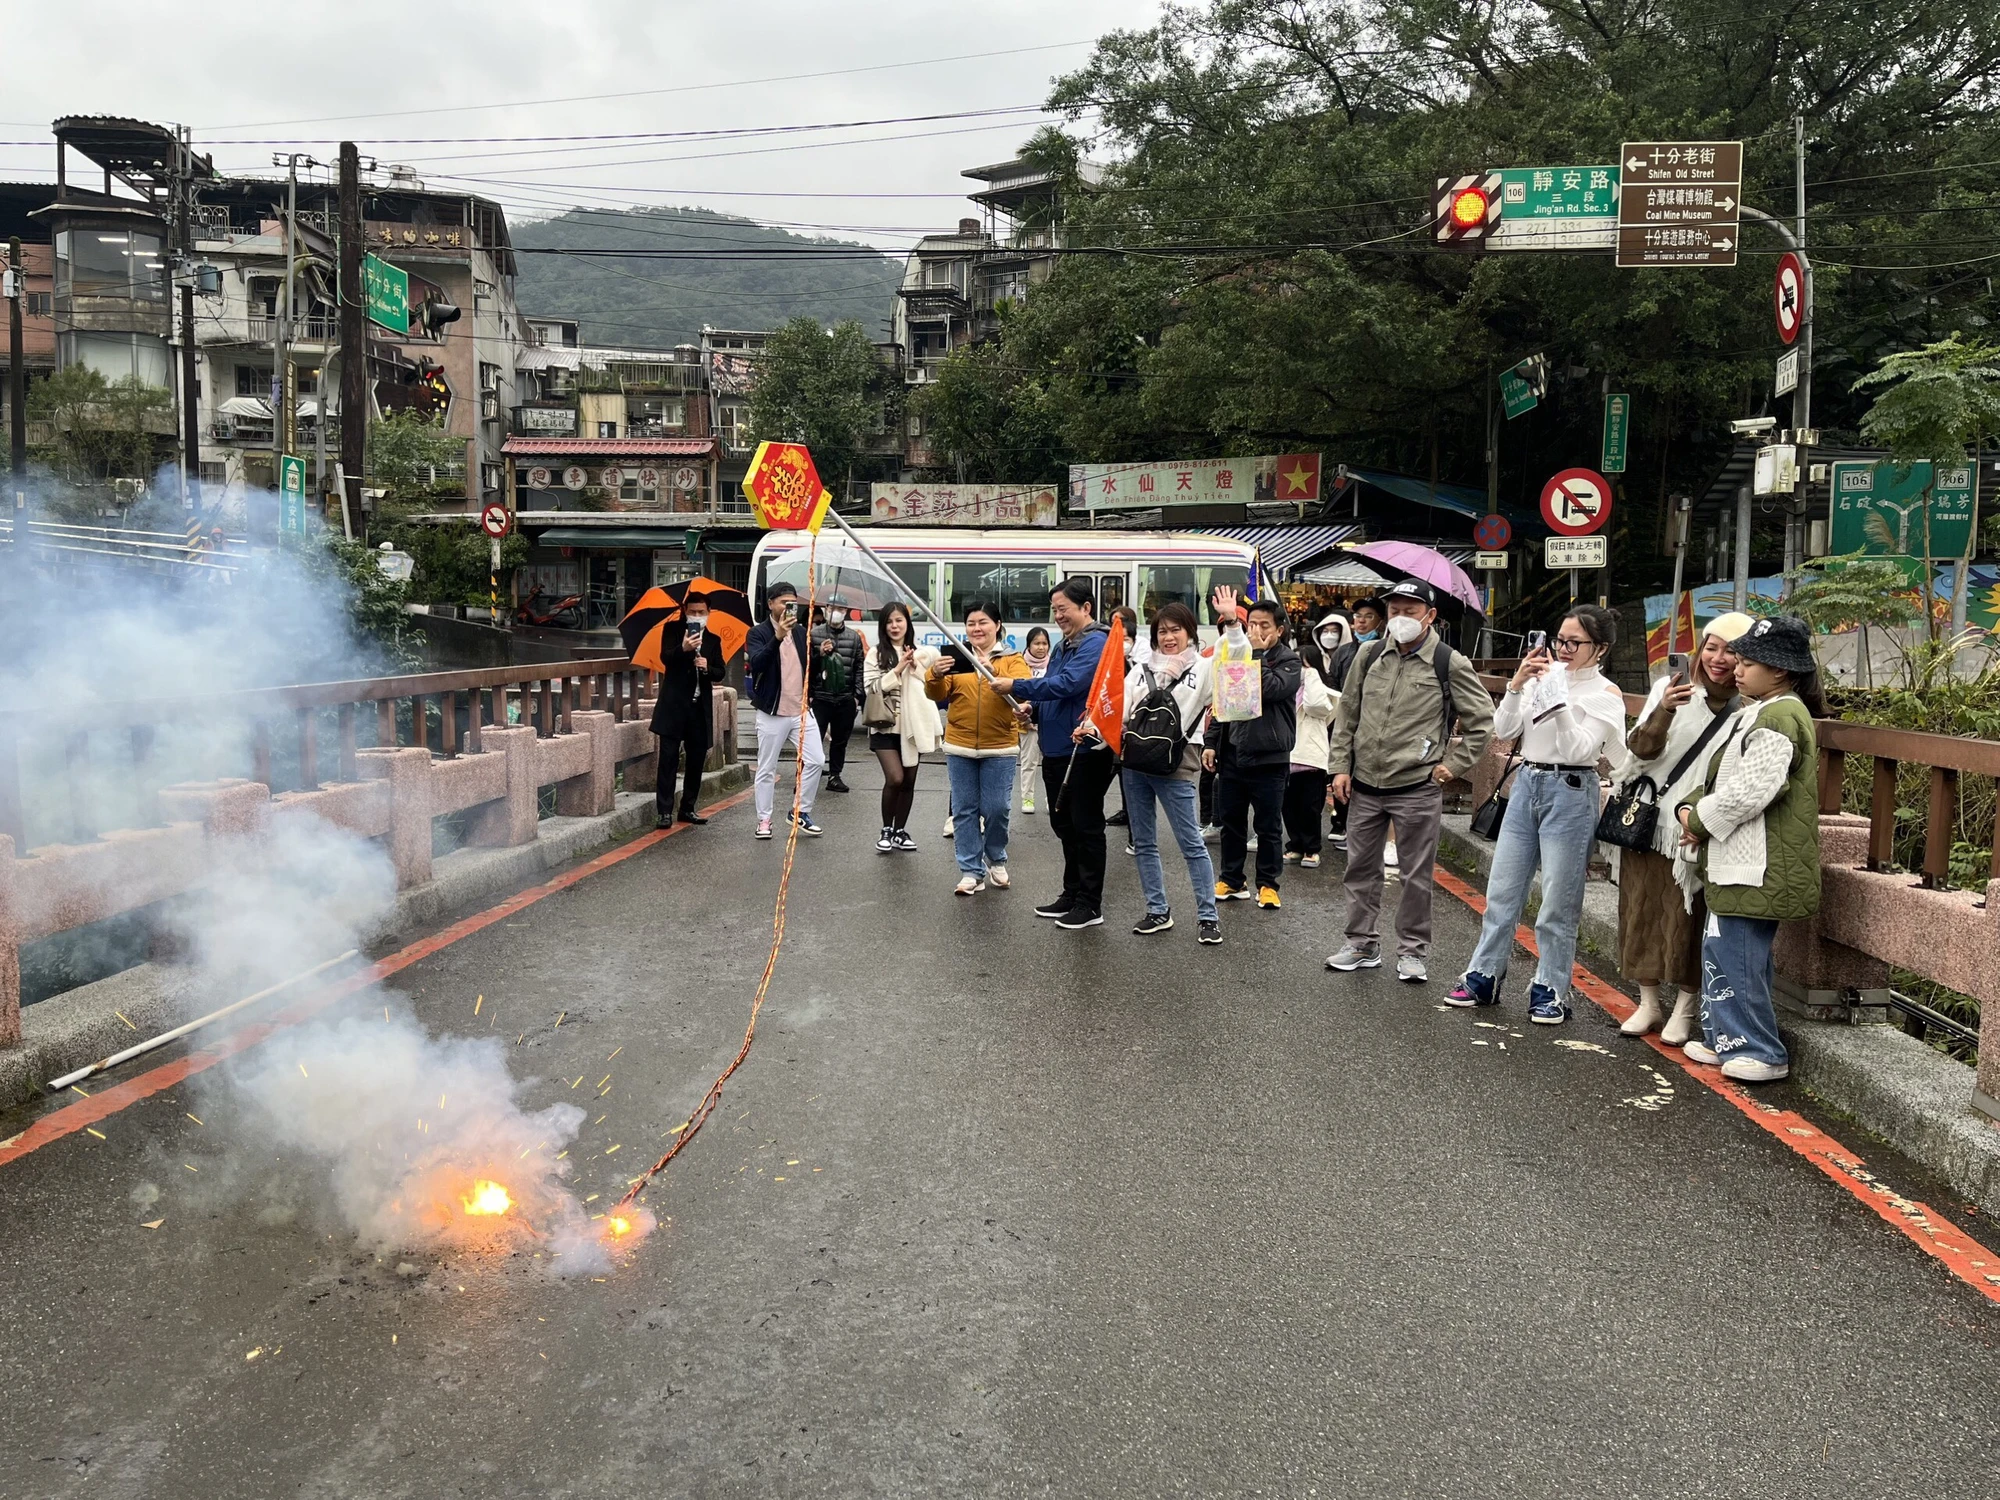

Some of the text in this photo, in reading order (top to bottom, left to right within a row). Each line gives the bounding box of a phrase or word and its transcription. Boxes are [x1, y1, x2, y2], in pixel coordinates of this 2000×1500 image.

[1648, 147, 1716, 165] 十分老街
[1648, 168, 1715, 179] Shifen Old Street
[1533, 170, 1610, 191] 靜安路
[1507, 187, 1523, 197] 106
[1551, 191, 1595, 203] 三段
[1646, 188, 1714, 206] 台灣煤礦博物館
[1534, 203, 1609, 215] Jing'an Rd. Sec. 3
[1645, 209, 1713, 220] Coal Mine Museum
[364, 226, 461, 247] 味的咖啡
[1644, 229, 1711, 247] 十分旅遊服務中心
[1168, 459, 1228, 470] 0975-812-611
[1101, 470, 1234, 495] 水仙天燈
[1845, 475, 1868, 487] 106
[902, 489, 1022, 519] 金莎小品
[1839, 496, 1873, 510] 石碇
[1938, 493, 1971, 509] 瑞芳
[1549, 541, 1602, 551] 假日禁止左轉
[1549, 554, 1602, 564] 公車除外
